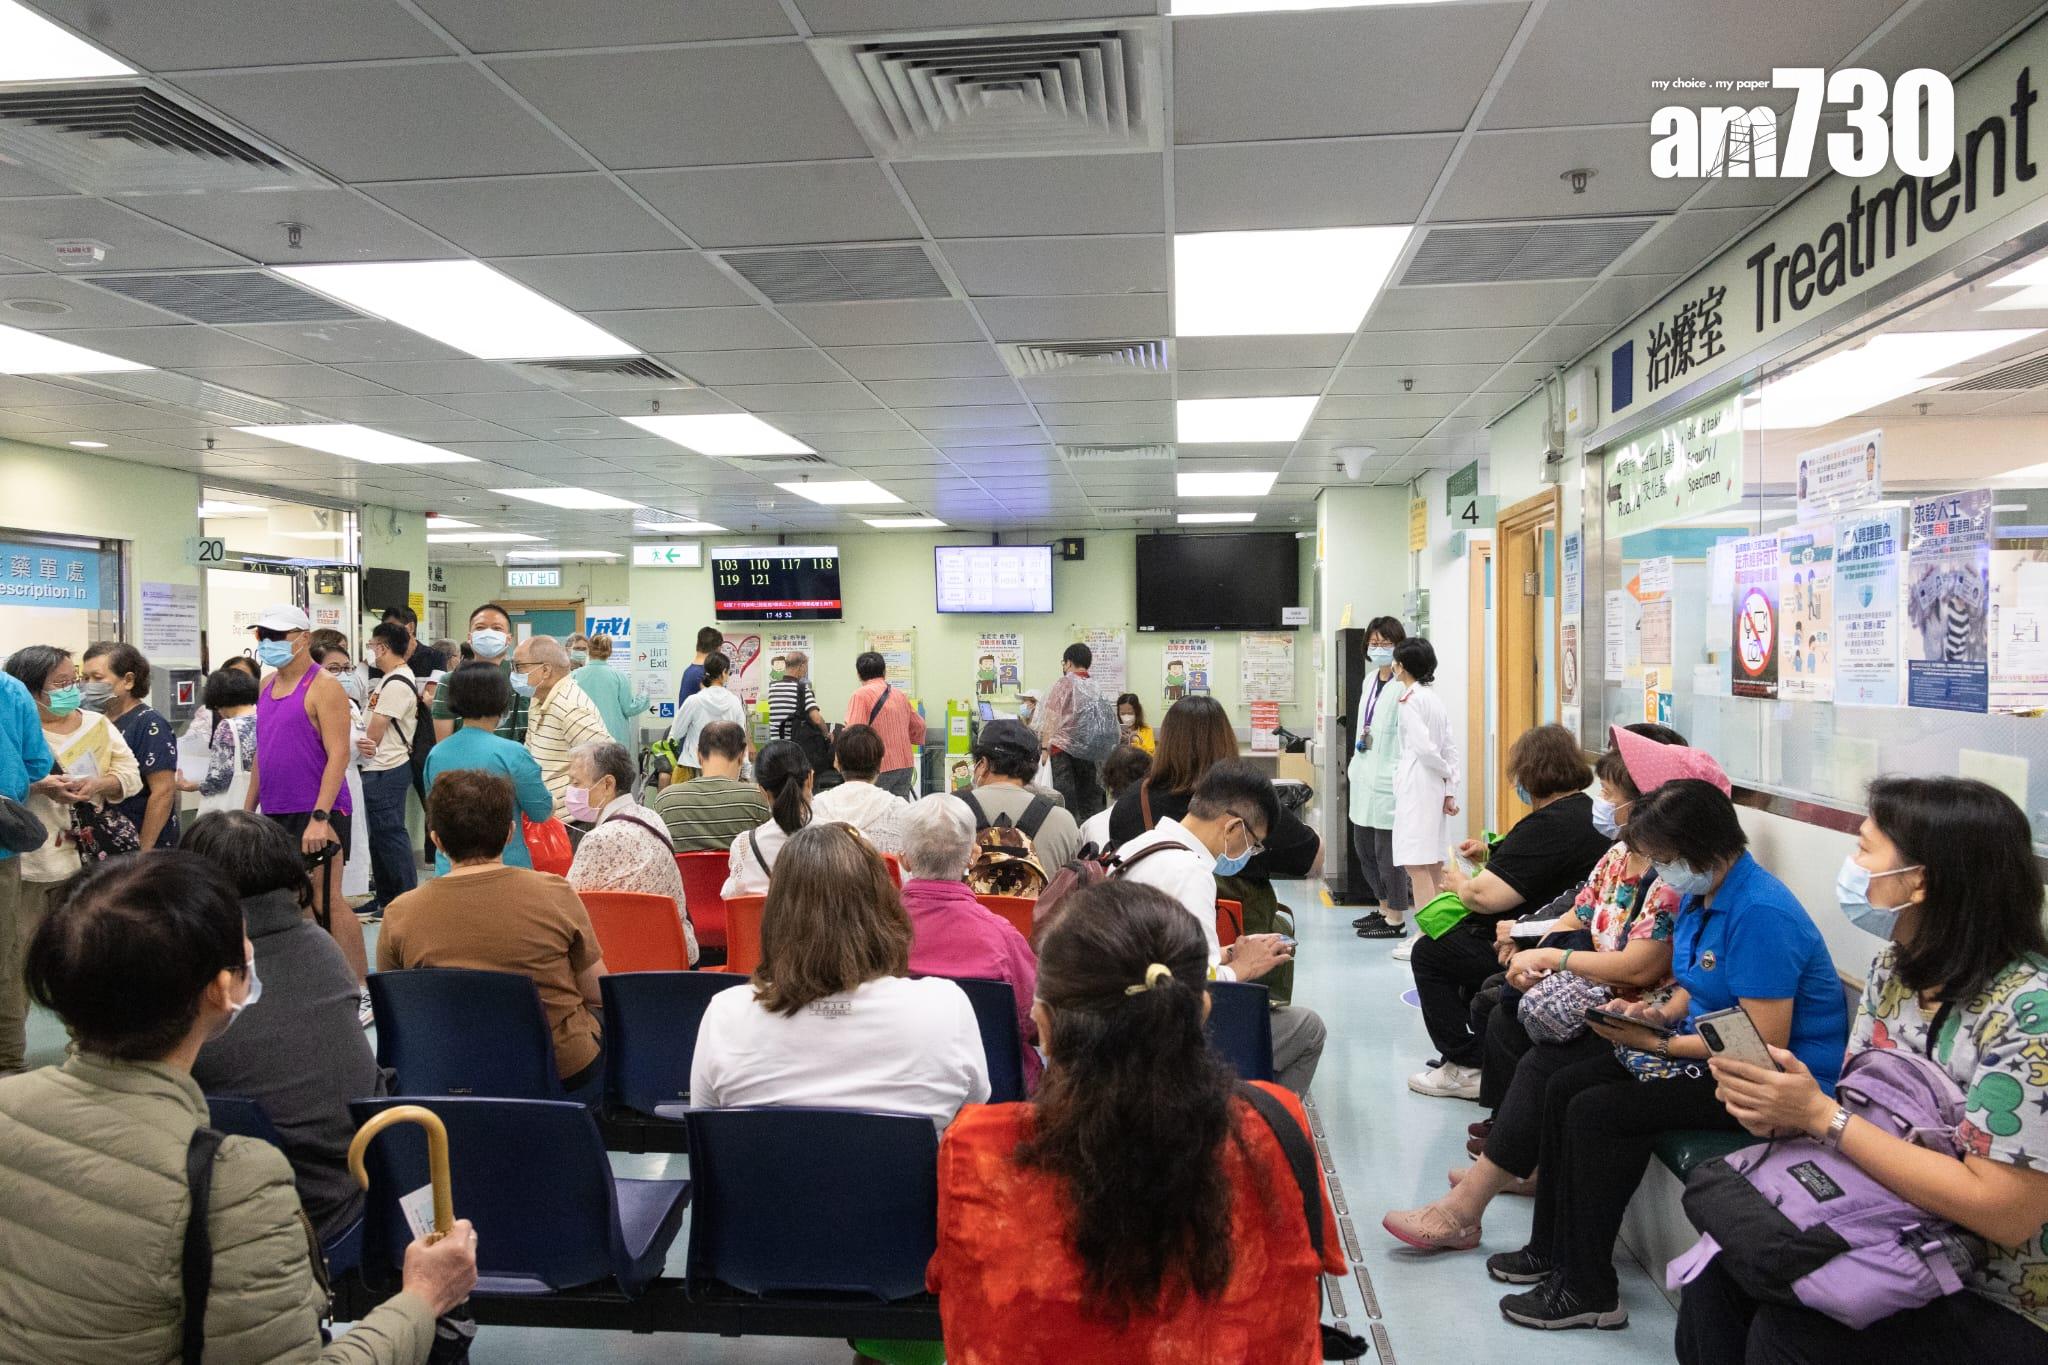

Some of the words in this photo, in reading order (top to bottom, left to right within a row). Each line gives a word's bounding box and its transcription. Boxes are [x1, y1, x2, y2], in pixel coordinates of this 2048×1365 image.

[1746, 65, 2039, 333] Treatment
[1646, 285, 1728, 392] 治療室
[1688, 470, 1721, 495] Specimen
[1461, 500, 1480, 525] 4
[1914, 499, 1961, 524] 求診人士
[1843, 522, 1892, 544] 人護理區內
[198, 541, 224, 561] 20
[718, 560, 738, 571] 103
[749, 559, 770, 570] 110
[781, 559, 801, 570] 117
[812, 558, 833, 569] 118
[511, 573, 534, 586] EXIT
[537, 572, 557, 585] 出口
[719, 575, 740, 586] 119
[751, 574, 770, 585] 121
[73, 585, 87, 600] In
[650, 659, 668, 668] Exit
